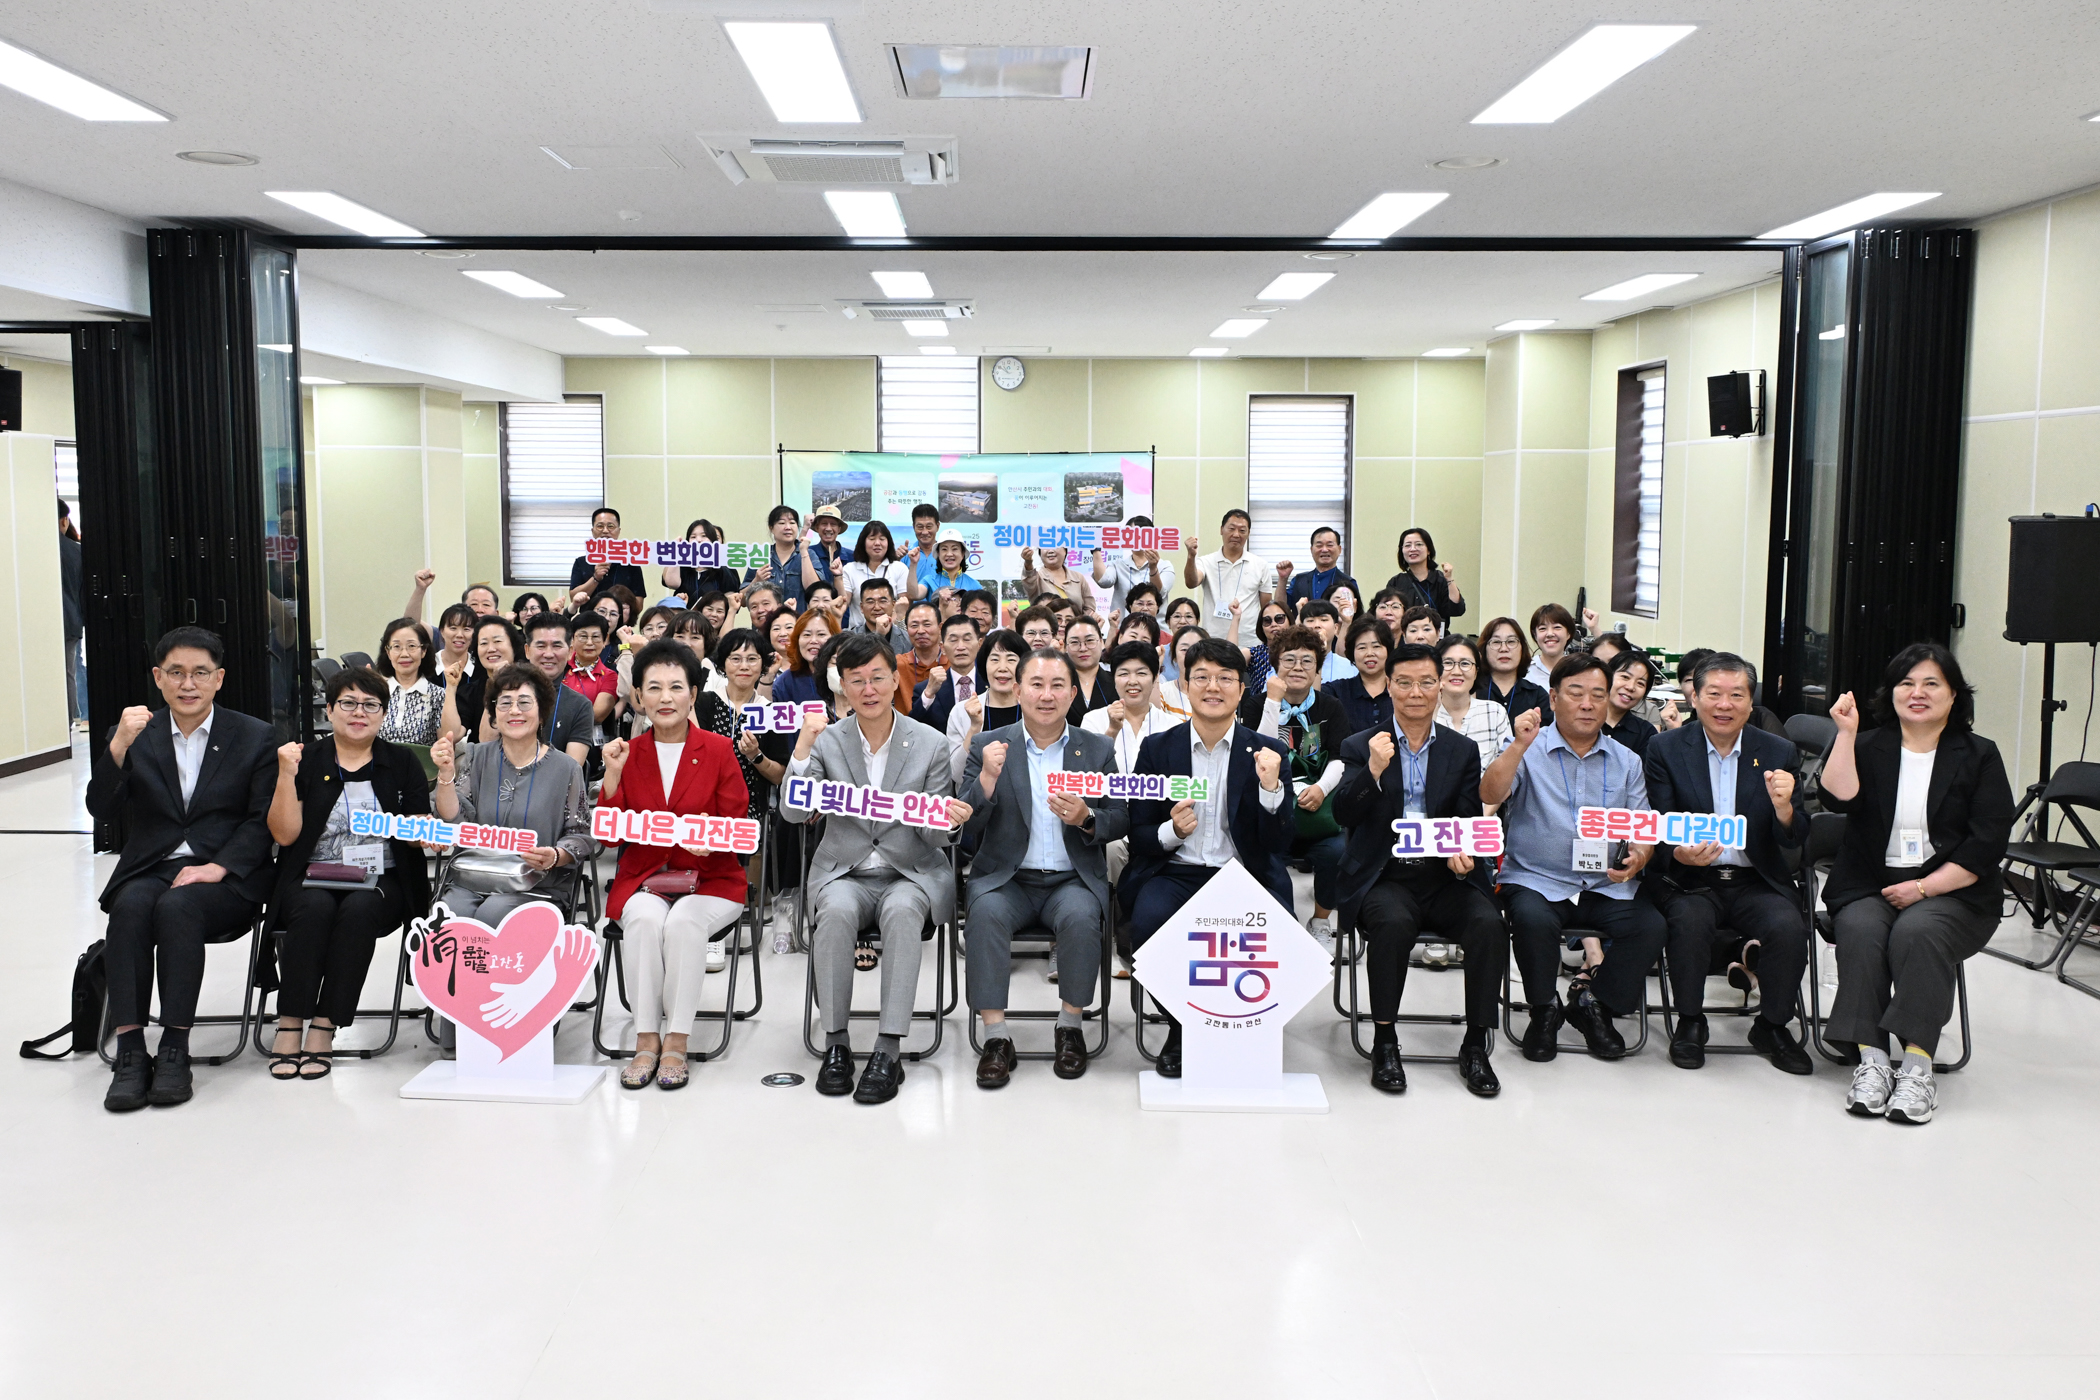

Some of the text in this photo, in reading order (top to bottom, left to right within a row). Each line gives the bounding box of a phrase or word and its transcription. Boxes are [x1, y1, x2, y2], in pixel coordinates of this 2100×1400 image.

[994, 525, 1180, 549] 정이 넘치는 문화마을
[586, 539, 769, 567] 행복한 변화의 중심
[789, 779, 812, 807] 더
[821, 783, 894, 819] 빛나는
[1047, 773, 1207, 800] 행복한 변화의 중심
[353, 812, 535, 853] 정이 넘치는 문화마을
[593, 810, 757, 851] 더 나은 고잔동
[1581, 810, 1744, 846] 좋은건 다같이
[1579, 861, 1601, 869] 박노현
[410, 907, 458, 996] 情
[462, 946, 490, 960] 문화
[470, 936, 490, 944] 넘치는
[464, 959, 489, 974] 마을
[489, 952, 525, 973] 고잔동
[1188, 932, 1278, 1003] 감동
[1204, 1018, 1262, 1029] 고잔동 in 안산
